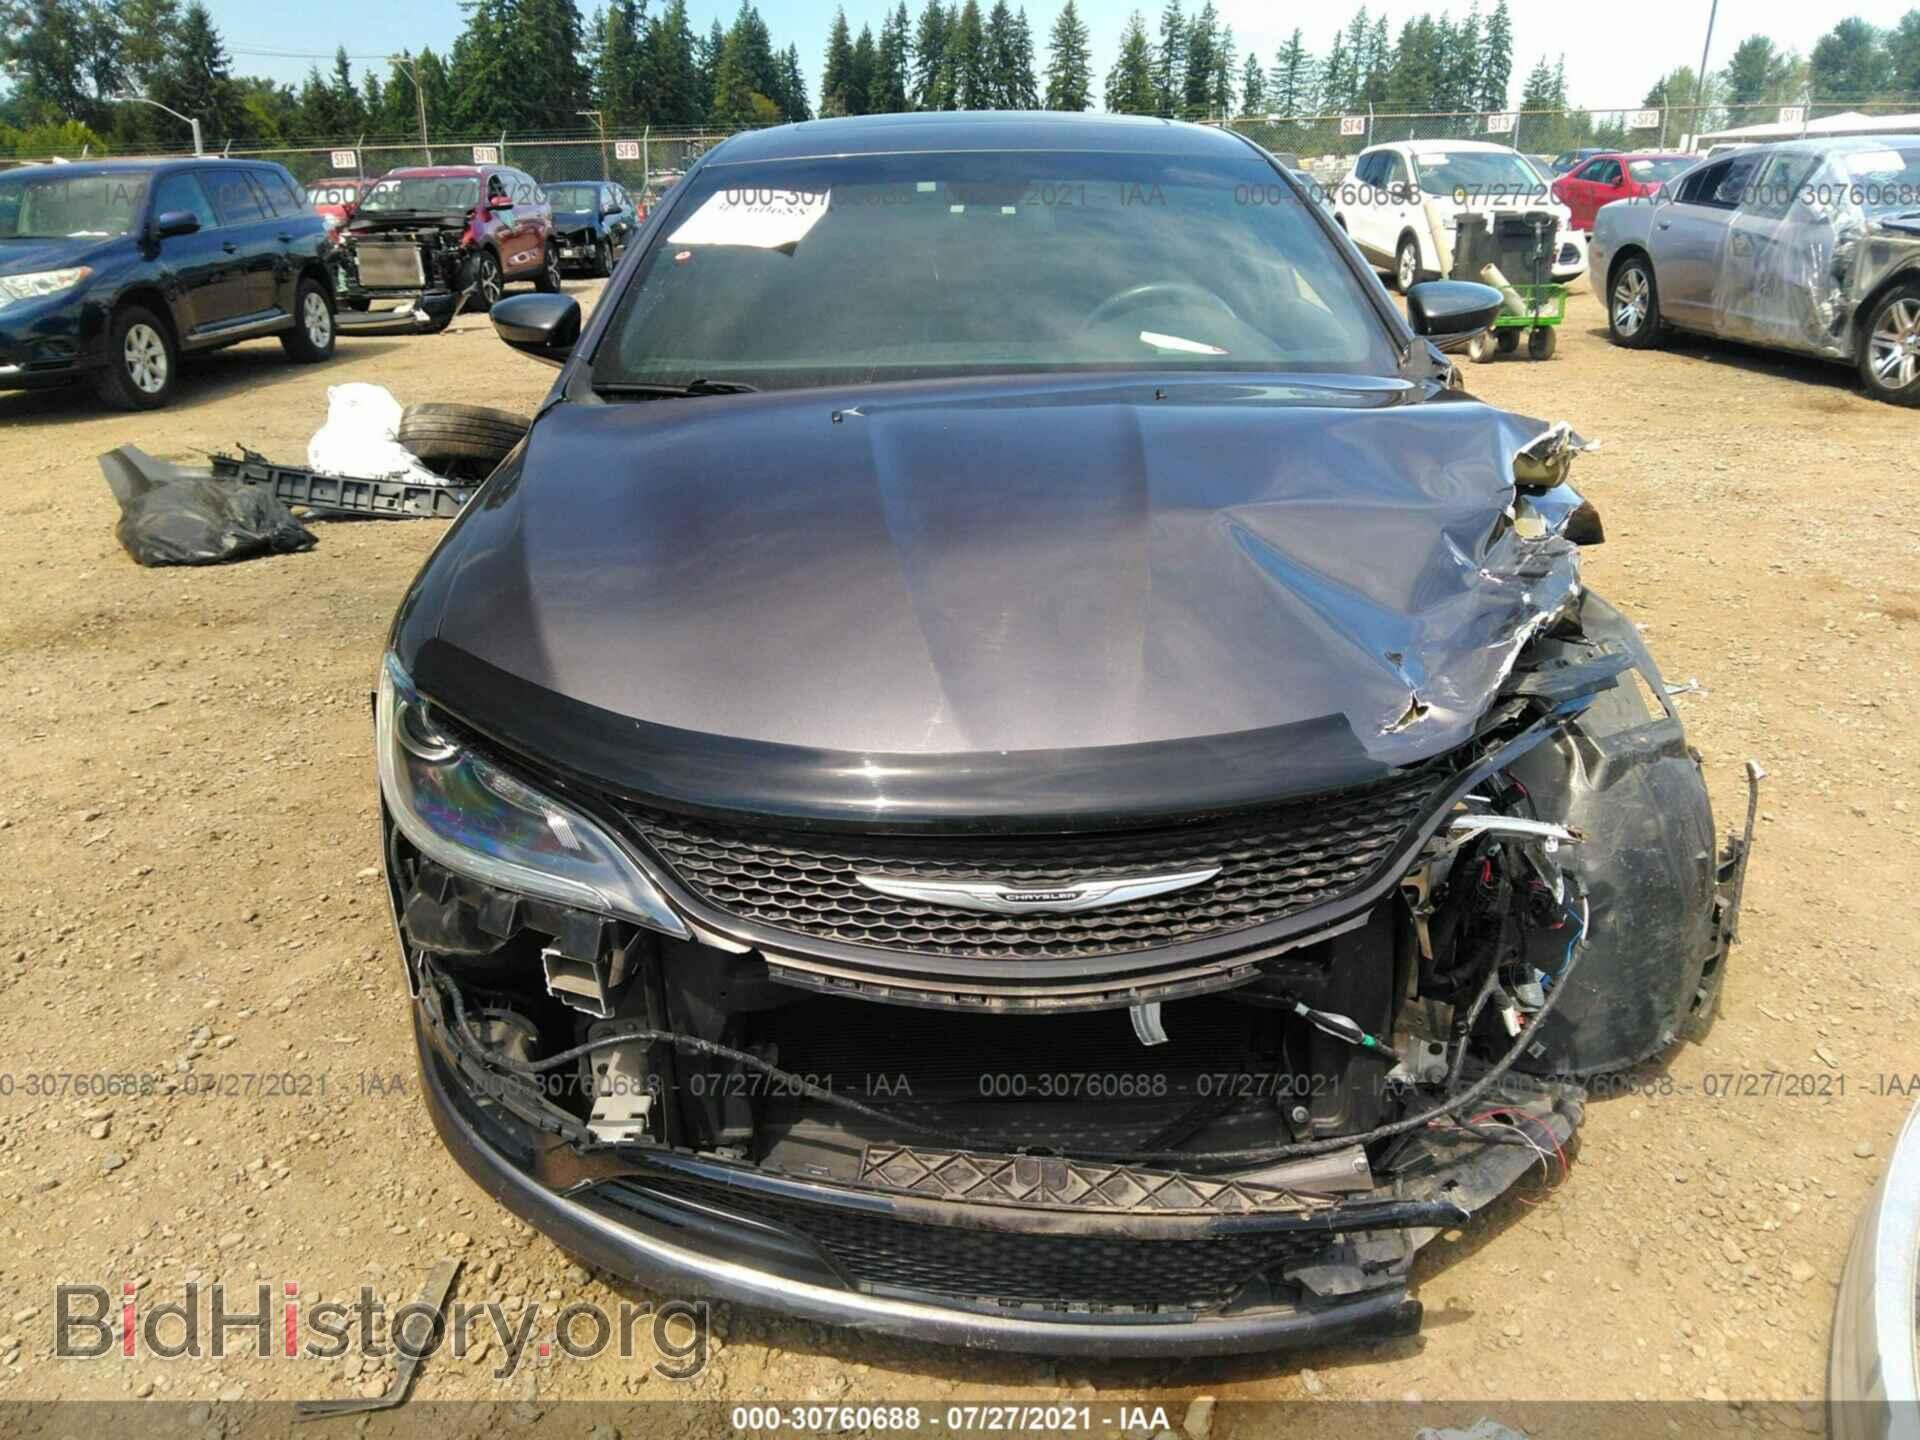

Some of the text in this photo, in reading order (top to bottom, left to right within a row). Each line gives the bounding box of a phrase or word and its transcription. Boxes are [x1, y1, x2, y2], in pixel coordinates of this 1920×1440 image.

[1343, 118, 1362, 133] SF4
[475, 148, 497, 161] SF10
[617, 143, 637, 157] SF9
[335, 152, 353, 166] SF11
